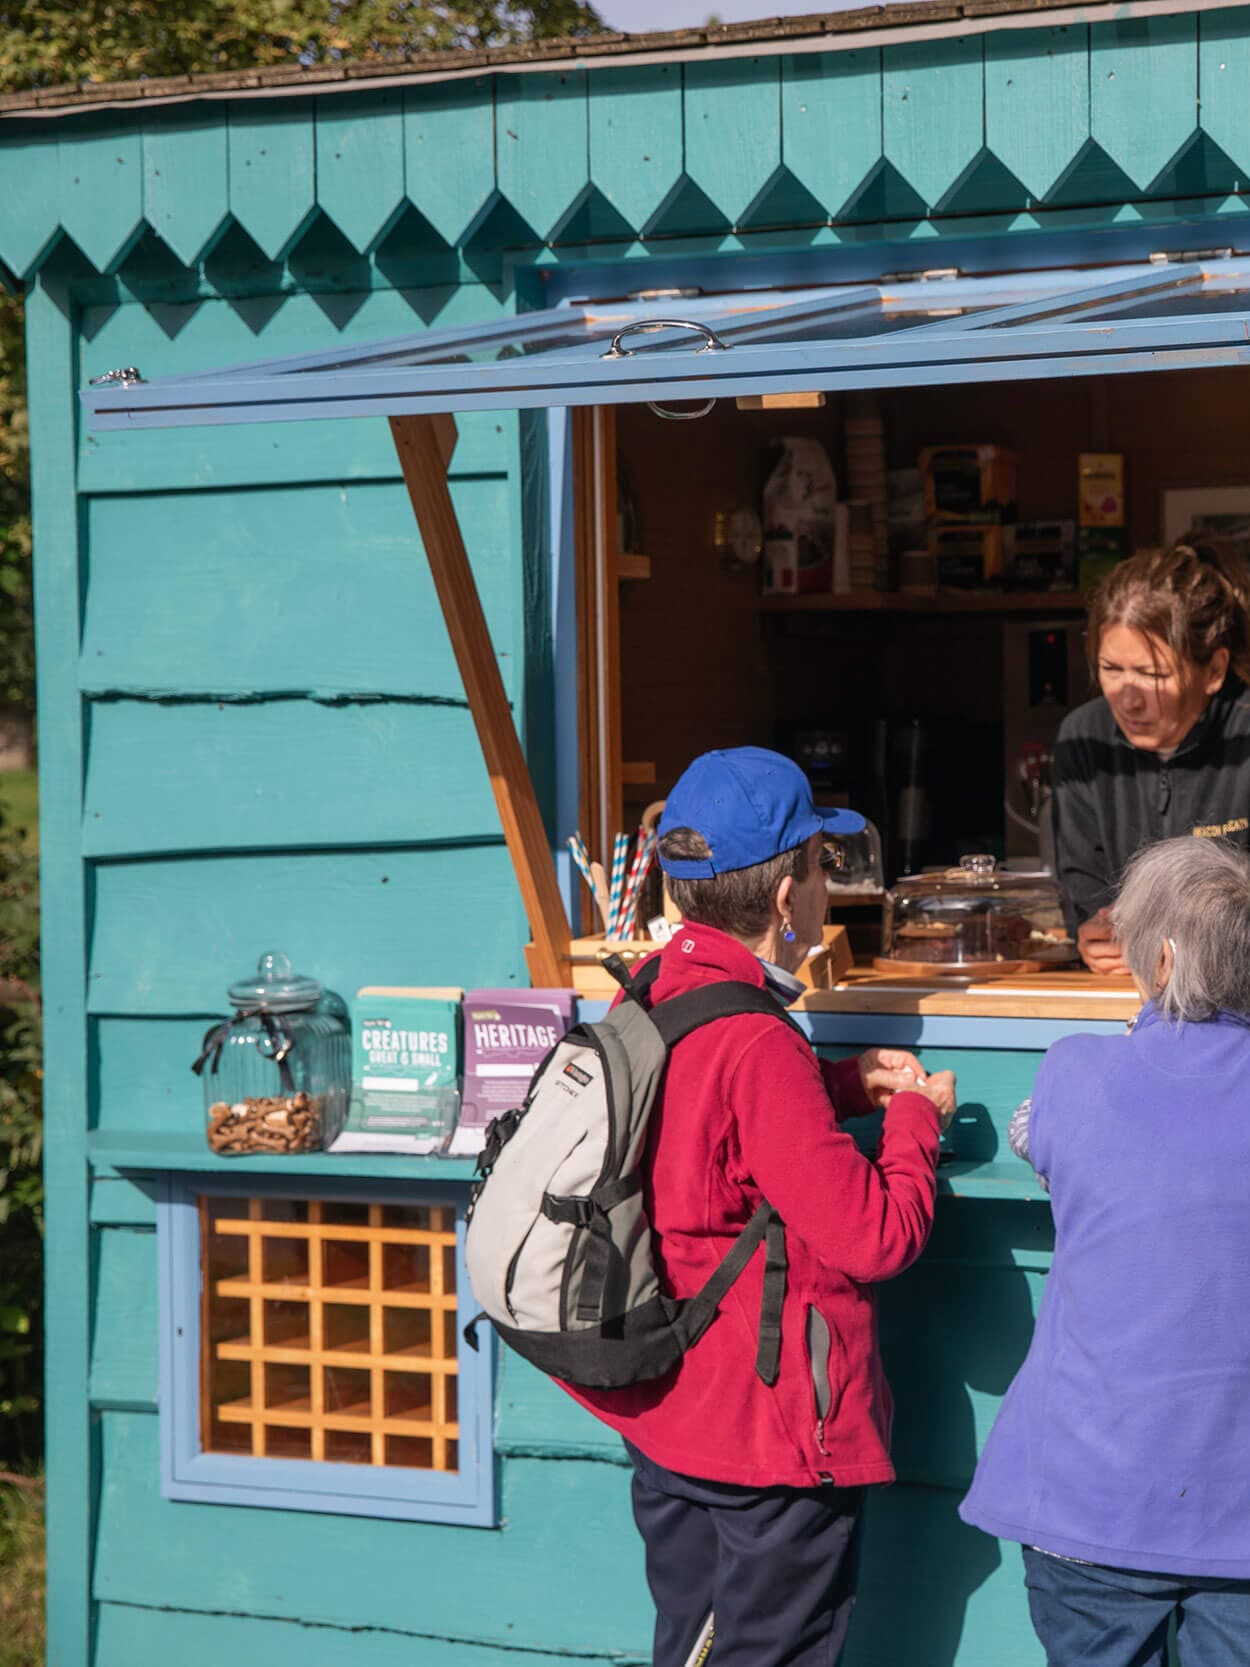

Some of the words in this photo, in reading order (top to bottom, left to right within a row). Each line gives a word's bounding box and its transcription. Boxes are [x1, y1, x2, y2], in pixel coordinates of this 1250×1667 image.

[361, 1030, 448, 1053] CREATURES
[475, 1024, 558, 1050] HERITAGE
[369, 1050, 399, 1064] GREAT
[411, 1051, 443, 1067] SMALL
